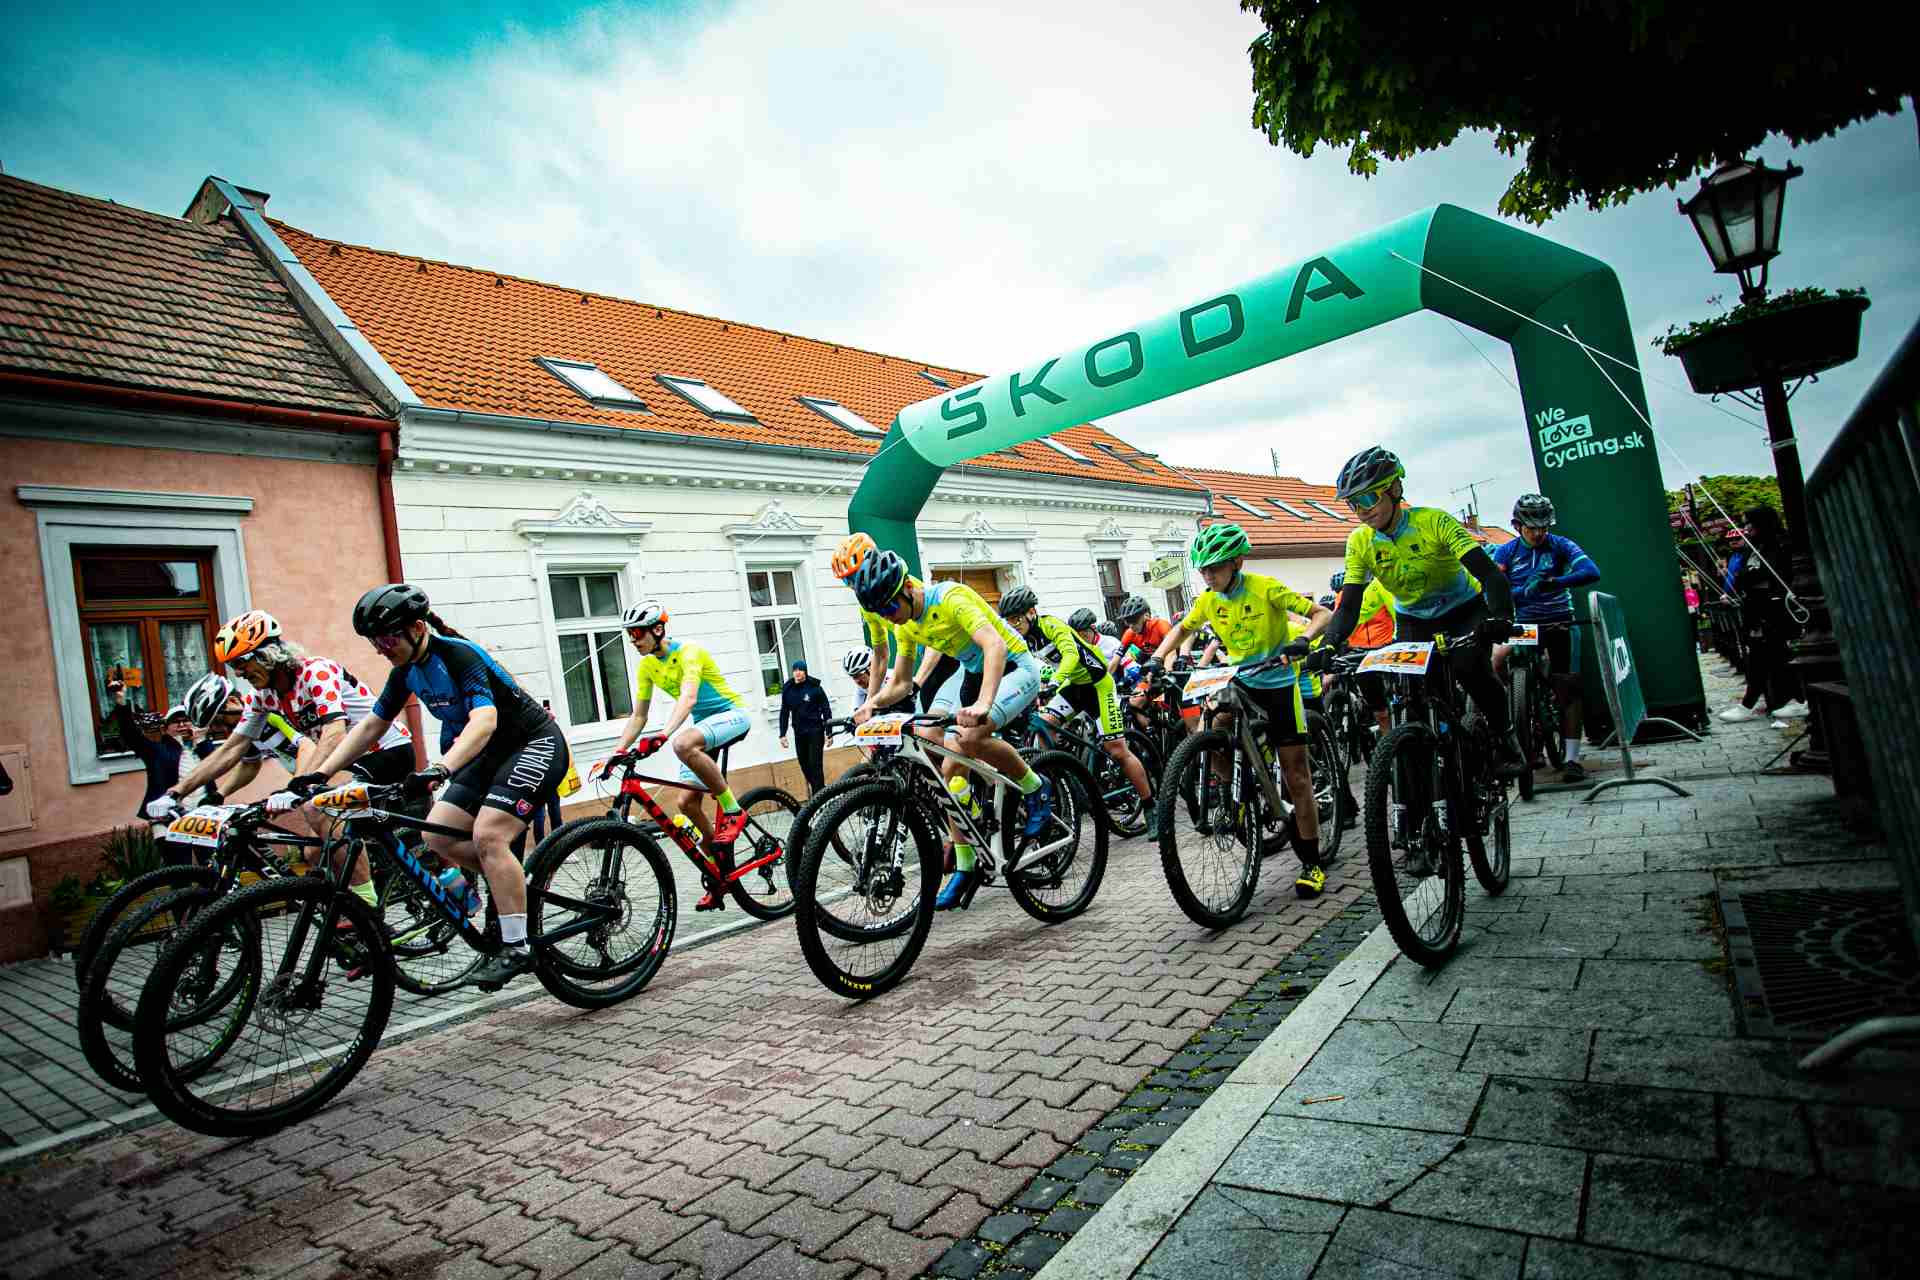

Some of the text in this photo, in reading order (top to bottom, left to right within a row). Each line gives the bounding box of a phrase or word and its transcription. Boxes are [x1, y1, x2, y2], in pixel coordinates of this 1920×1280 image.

[1536, 408, 1565, 428] We
[1544, 431, 1645, 468] Cycling.sk
[507, 736, 557, 793] SLOVAKIA
